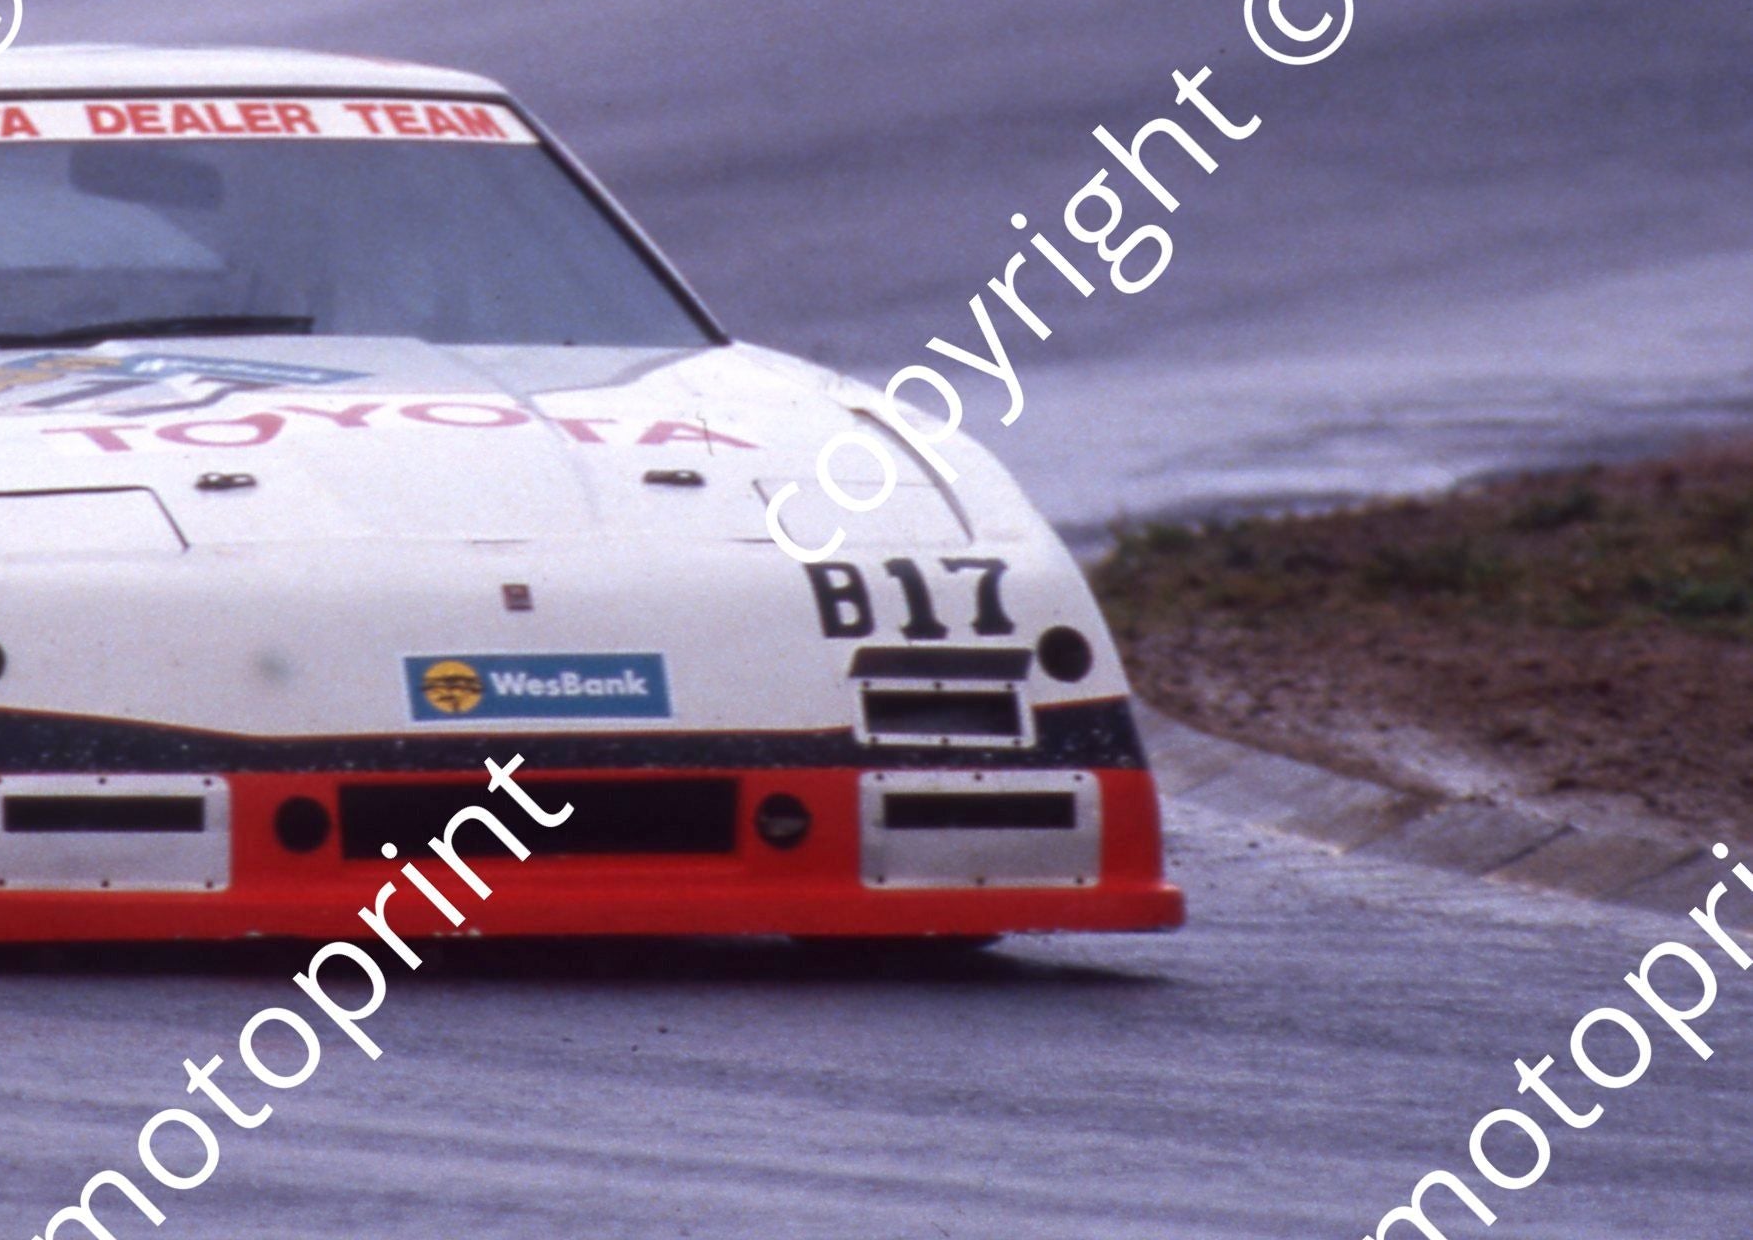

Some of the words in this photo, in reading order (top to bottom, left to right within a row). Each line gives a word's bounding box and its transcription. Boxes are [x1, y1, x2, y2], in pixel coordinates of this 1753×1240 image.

[87, 102, 322, 137] DEALER
[344, 103, 505, 138] TEAM
[40, 400, 759, 454] TOYOTA
[803, 556, 1016, 641] B17
[492, 671, 648, 697] WesBank
